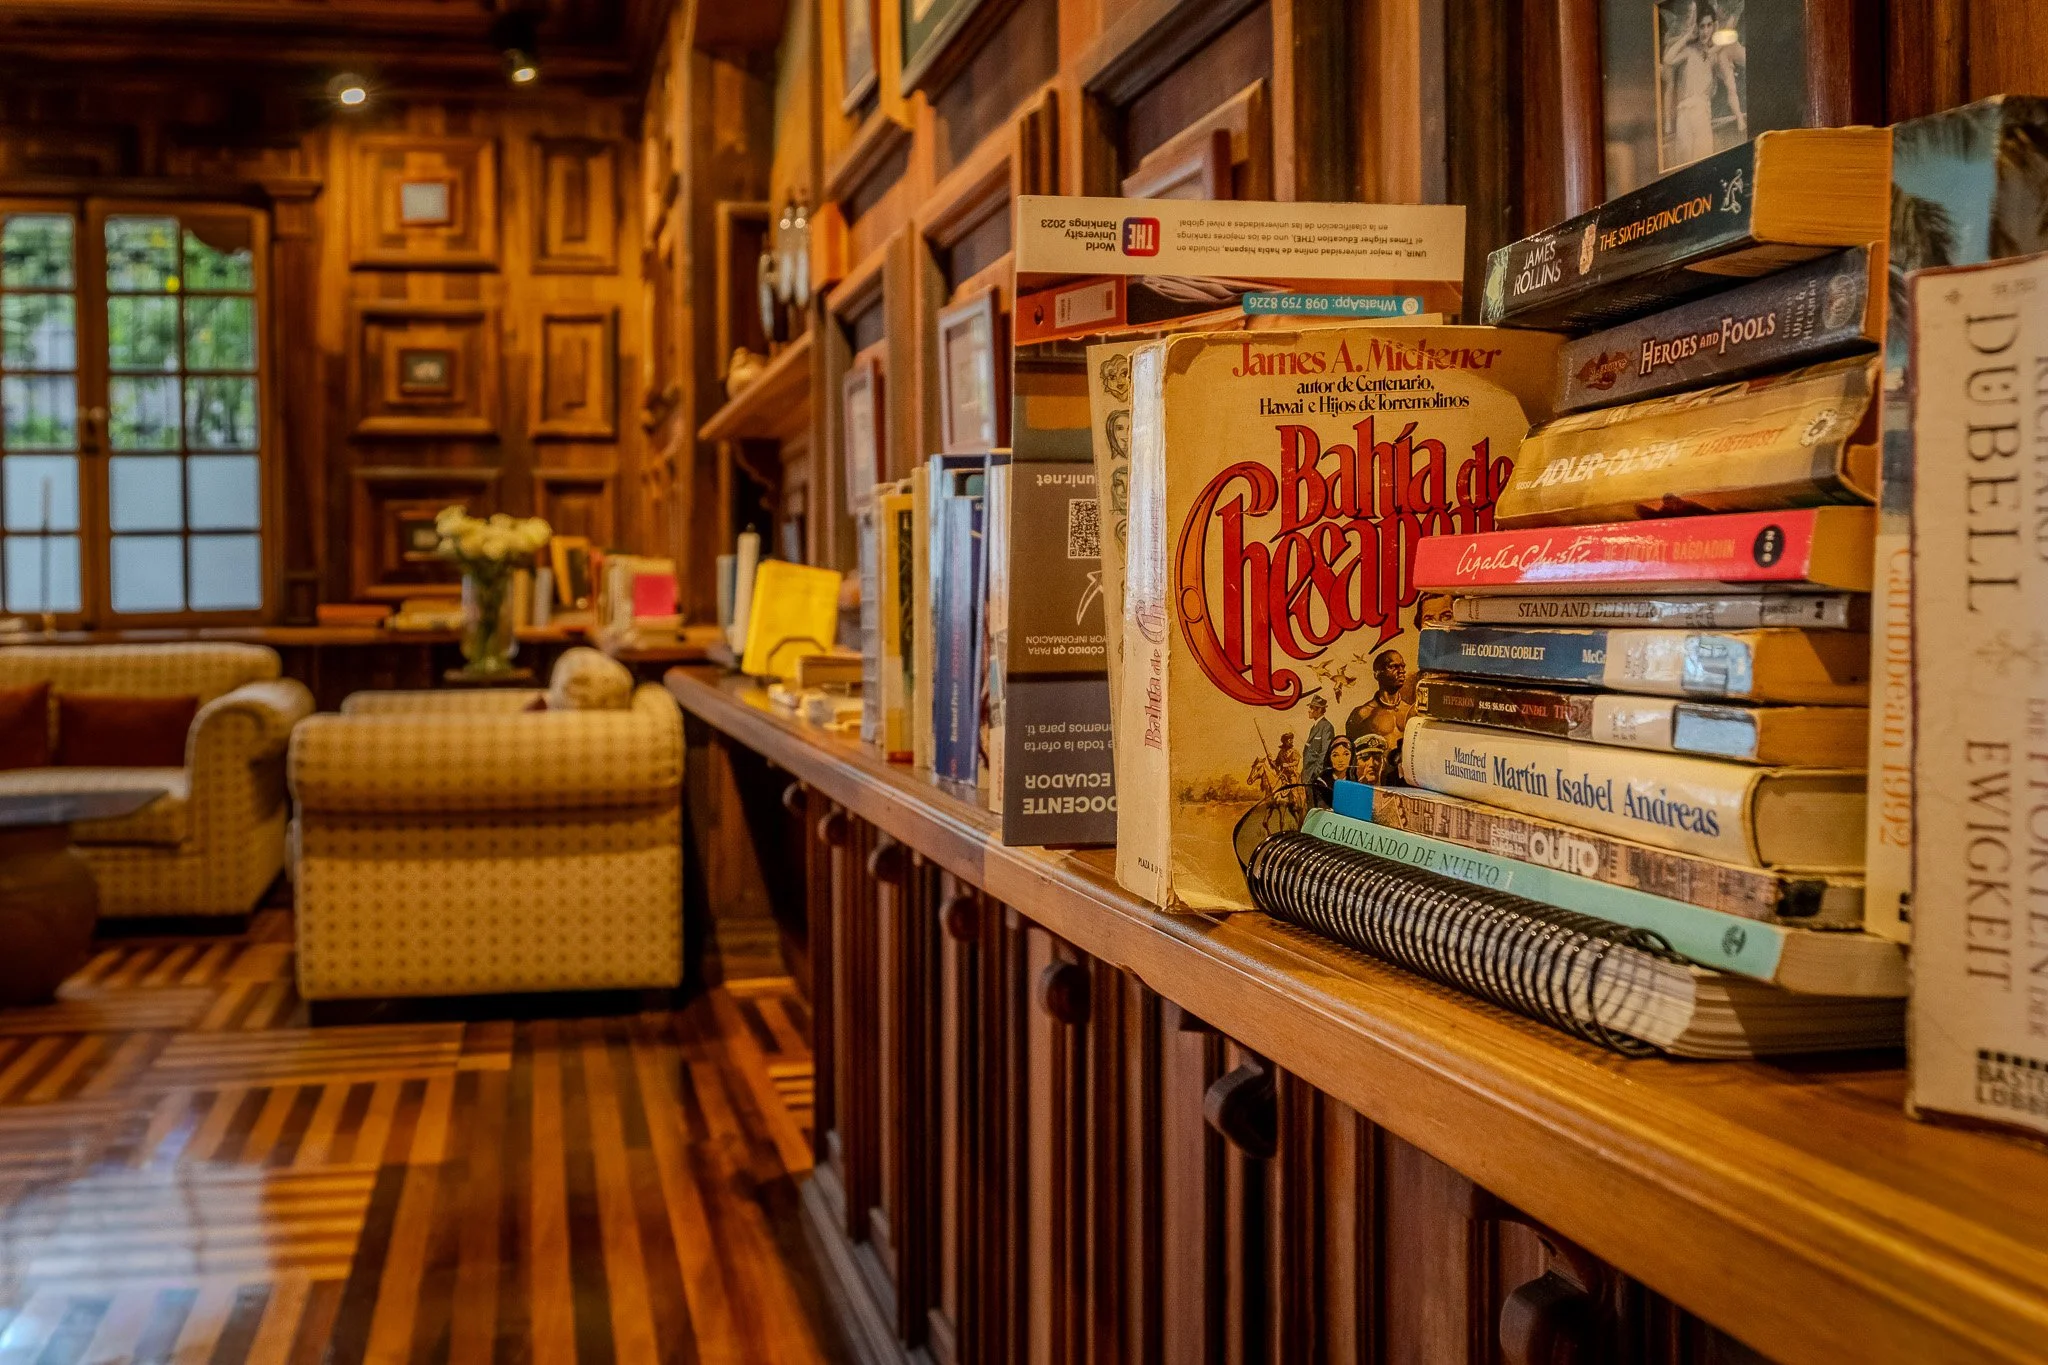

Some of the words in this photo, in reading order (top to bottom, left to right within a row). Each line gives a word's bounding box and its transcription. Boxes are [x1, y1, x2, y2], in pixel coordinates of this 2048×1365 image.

[1041, 218, 1066, 229] 2023
[1069, 218, 1117, 230] Rankings
[1206, 219, 1226, 227] nivel
[1234, 220, 1289, 229] universidades
[1292, 222, 1303, 230] las
[1304, 222, 1315, 230] de
[1317, 222, 1367, 232] clasificación
[1600, 231, 1617, 252] THE
[1617, 218, 1647, 245] SIXTH
[1646, 193, 1713, 235] EXTINCTION
[1064, 228, 1117, 241] University
[1127, 223, 1154, 250] THE
[1176, 231, 1212, 241] rankings
[1213, 232, 1246, 242] mejores
[1248, 234, 1260, 242] los
[1261, 234, 1272, 242] de
[1317, 235, 1359, 244] Education
[1360, 235, 1388, 244] Higher
[1085, 242, 1116, 251] World
[1390, 237, 1414, 245] Times
[1258, 246, 1280, 255] habla
[1282, 247, 1292, 255] de
[1294, 247, 1319, 256] online
[1321, 247, 1368, 256] universidad
[1370, 247, 1393, 257] mejor
[1395, 249, 1402, 257] la
[1404, 249, 1427, 258] UNIR,
[1523, 240, 1557, 271] JAMES
[1513, 259, 1563, 297] ROLLINS
[1250, 297, 1277, 309] 8226
[1282, 297, 1301, 309] 759
[1305, 298, 1328, 310] 098
[1332, 296, 1397, 311] WhatsApp:
[1637, 334, 1699, 377] HEROES
[1718, 312, 1777, 354] FOOLS
[1232, 341, 1327, 378] James
[1330, 338, 1364, 375] A.
[1366, 337, 1503, 373] Michener
[1297, 378, 1336, 395] autor
[1337, 375, 1355, 393] de
[1355, 374, 1436, 394] Centenario,
[1259, 397, 1305, 416] Hawai
[1307, 399, 1316, 413] e
[1319, 395, 1357, 418] Hijos
[1358, 394, 1377, 411] de
[1375, 391, 1470, 411] Torremolinos
[1531, 439, 1686, 490] ADLER-OLSEN
[1965, 313, 2020, 614] DÜBELL
[1269, 414, 1455, 543] Bahía
[1456, 436, 1515, 508] de
[1456, 541, 1520, 580] Agatha
[1517, 535, 1593, 573] Christie
[1173, 460, 1497, 711] Chesap
[1517, 602, 1558, 618] STAND
[1560, 602, 1590, 618] AND
[1025, 635, 1088, 645] INFORMACIÓN
[1028, 646, 1051, 655] PARA
[1052, 645, 1066, 655] QR
[1068, 646, 1105, 656] CÓDIGO
[1460, 643, 1477, 658] THE
[1477, 643, 1511, 659] GOLDEN
[1511, 646, 1547, 662] GOBLET
[1149, 648, 1162, 676] de
[1442, 695, 1475, 708] HYPERION
[1143, 676, 1164, 752] Bahía
[1520, 704, 1549, 718] ZINDEL
[1039, 721, 1066, 733] para
[1068, 723, 1113, 733] nemos
[1024, 740, 1062, 753] oferta
[1064, 740, 1074, 752] la
[1077, 740, 1105, 752] toda
[1453, 746, 1487, 769] Manfred
[1444, 759, 1488, 784] Hausmann
[1024, 772, 1111, 789] ECUADOR
[1492, 755, 1550, 798] Martin
[1556, 767, 1615, 814] Isabel
[1622, 782, 1721, 837] Andreas
[1022, 795, 1118, 815] DOCENTE
[1878, 763, 1912, 848] 1992
[1490, 823, 1528, 844] Essential
[1490, 837, 1514, 852] Guide
[1321, 821, 1410, 860] CAMINANDO
[1412, 846, 1437, 867] DE
[1436, 852, 1501, 886] NUEVO
[1529, 831, 1600, 877] QUITO
[1965, 739, 2012, 994] EWIGKEIT
